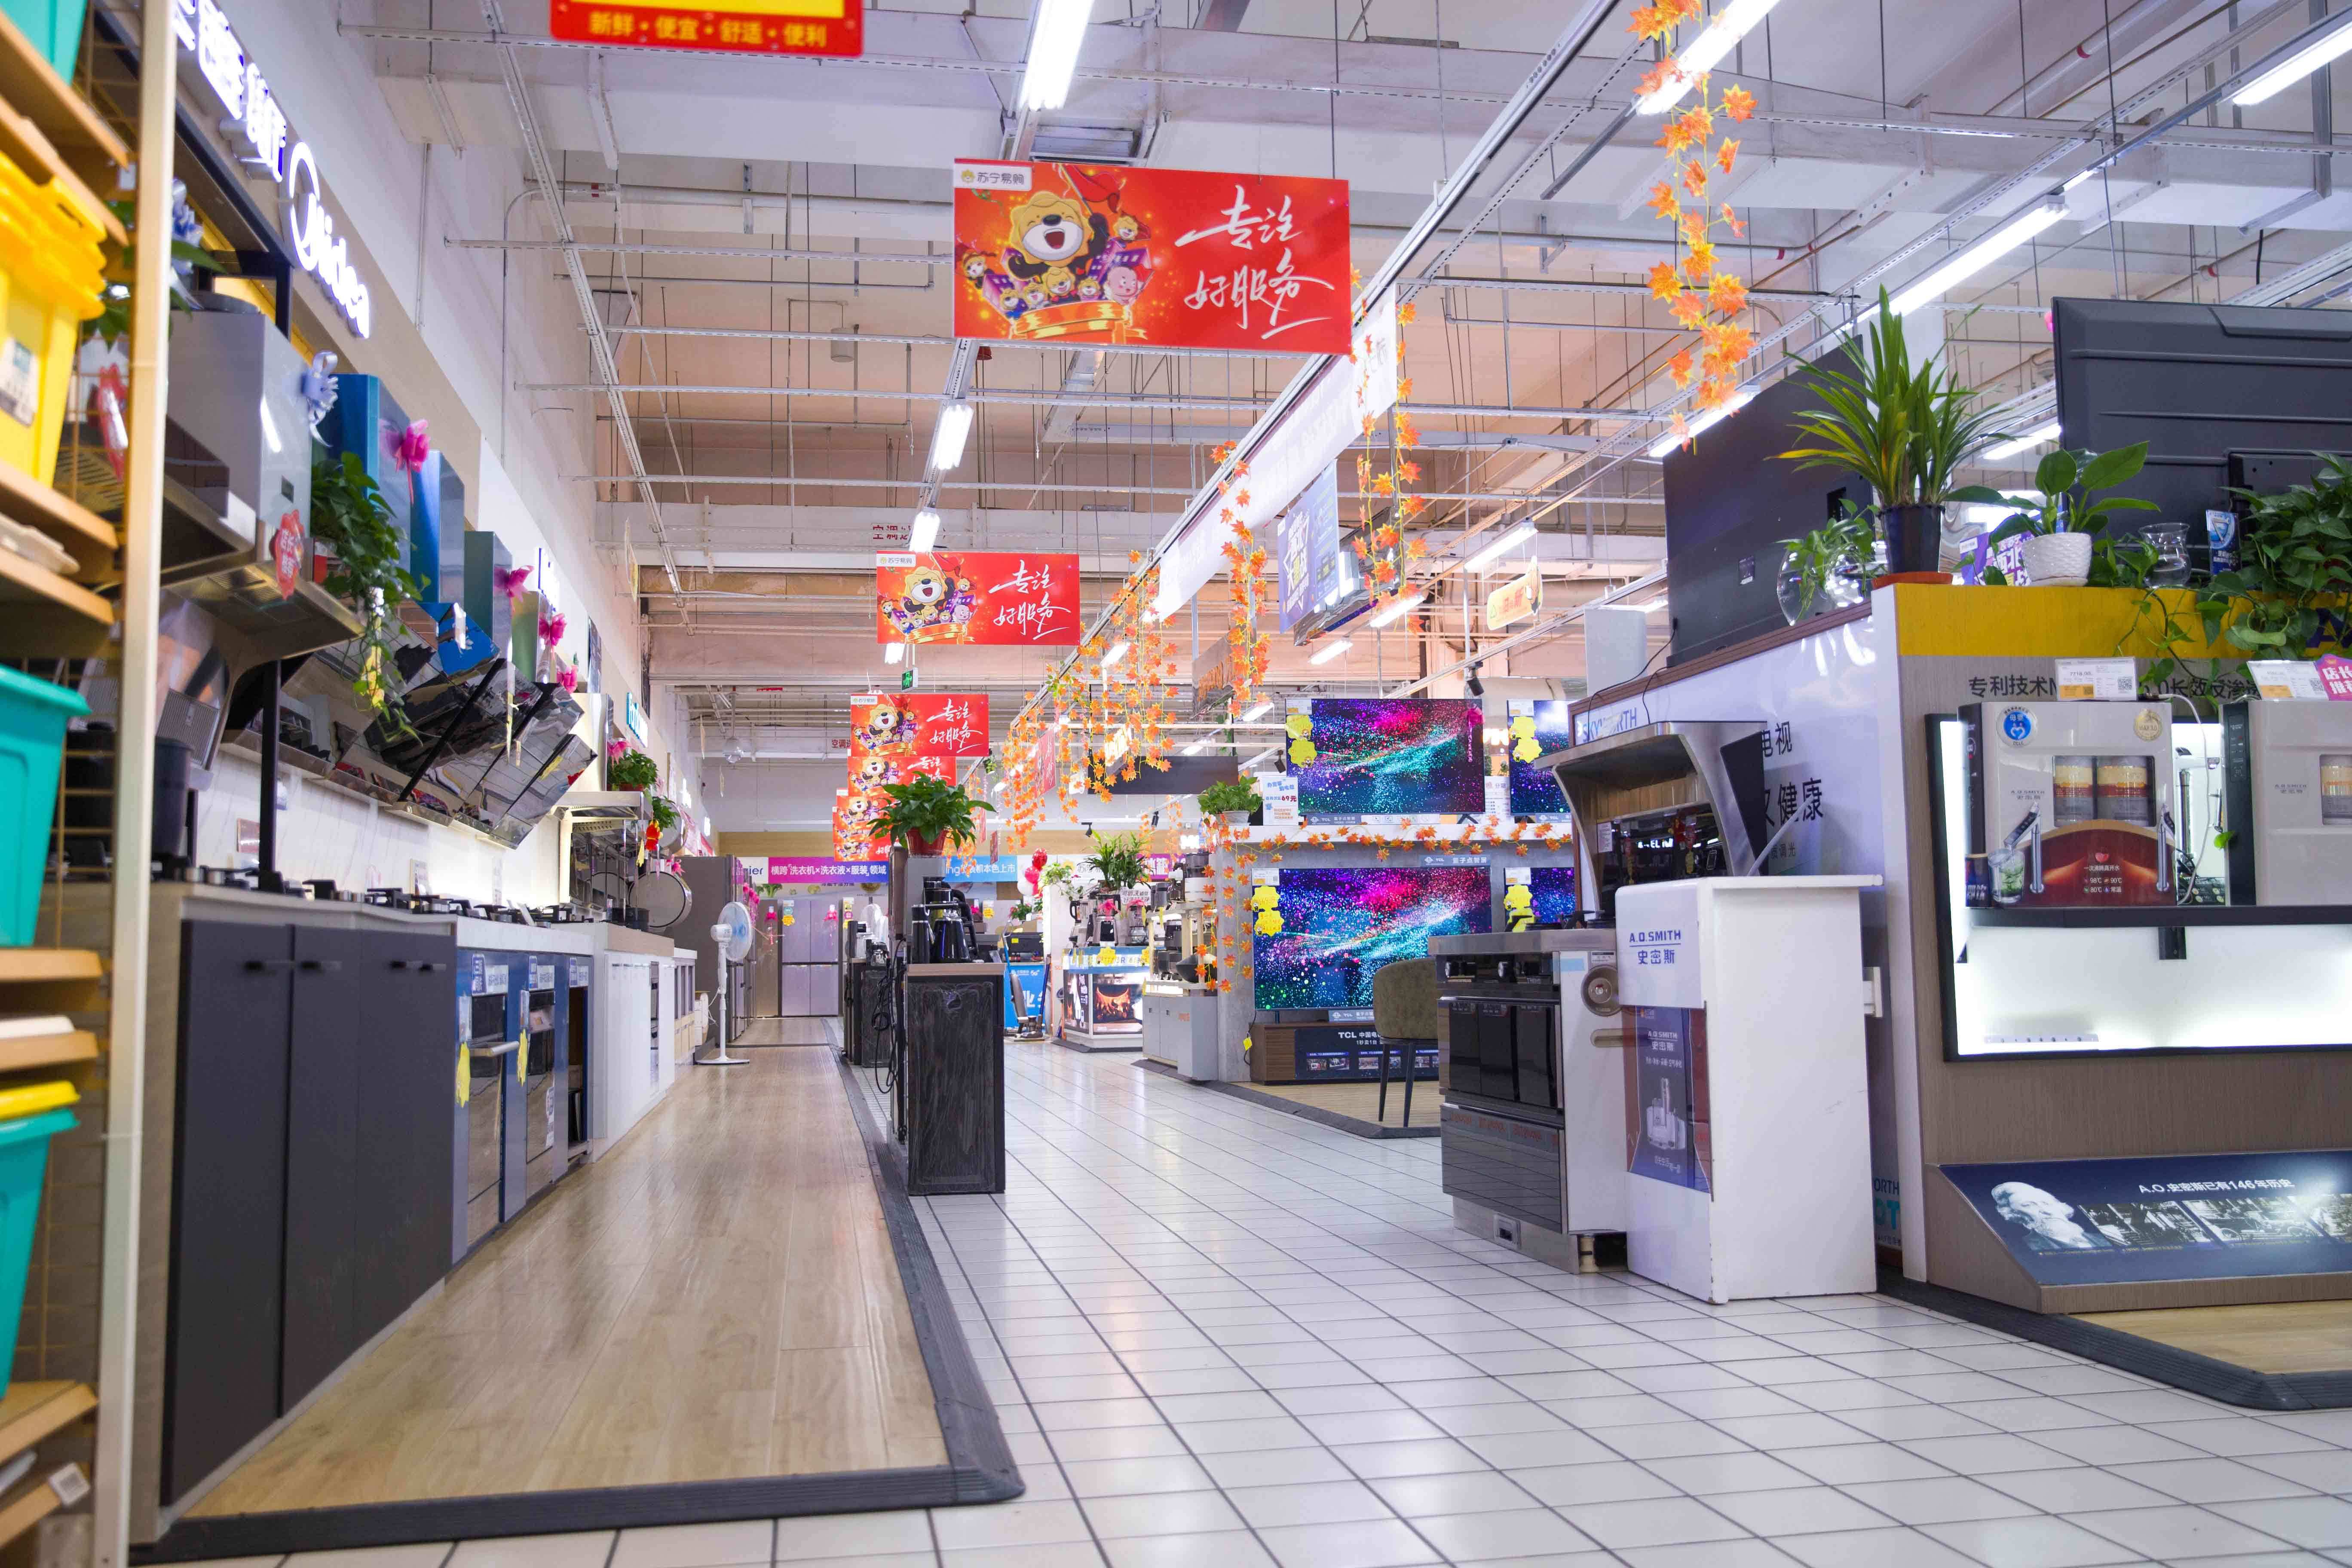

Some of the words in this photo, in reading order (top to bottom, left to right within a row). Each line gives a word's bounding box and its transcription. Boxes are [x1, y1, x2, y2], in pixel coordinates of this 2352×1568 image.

[977, 172, 1025, 186] 苏宁易购
[1174, 185, 1302, 249] 专注
[1185, 248, 1335, 330] 好服务
[989, 560, 1056, 594] 专注
[993, 591, 1071, 636] 好服务
[927, 698, 973, 722] 专注
[929, 721, 983, 750] 好服务
[1583, 707, 1637, 743] SKYRTH
[1629, 929, 1681, 943] A.O.SMITH
[1638, 949, 1675, 965] 史密斯
[1651, 1041, 1675, 1051] 史密斯
